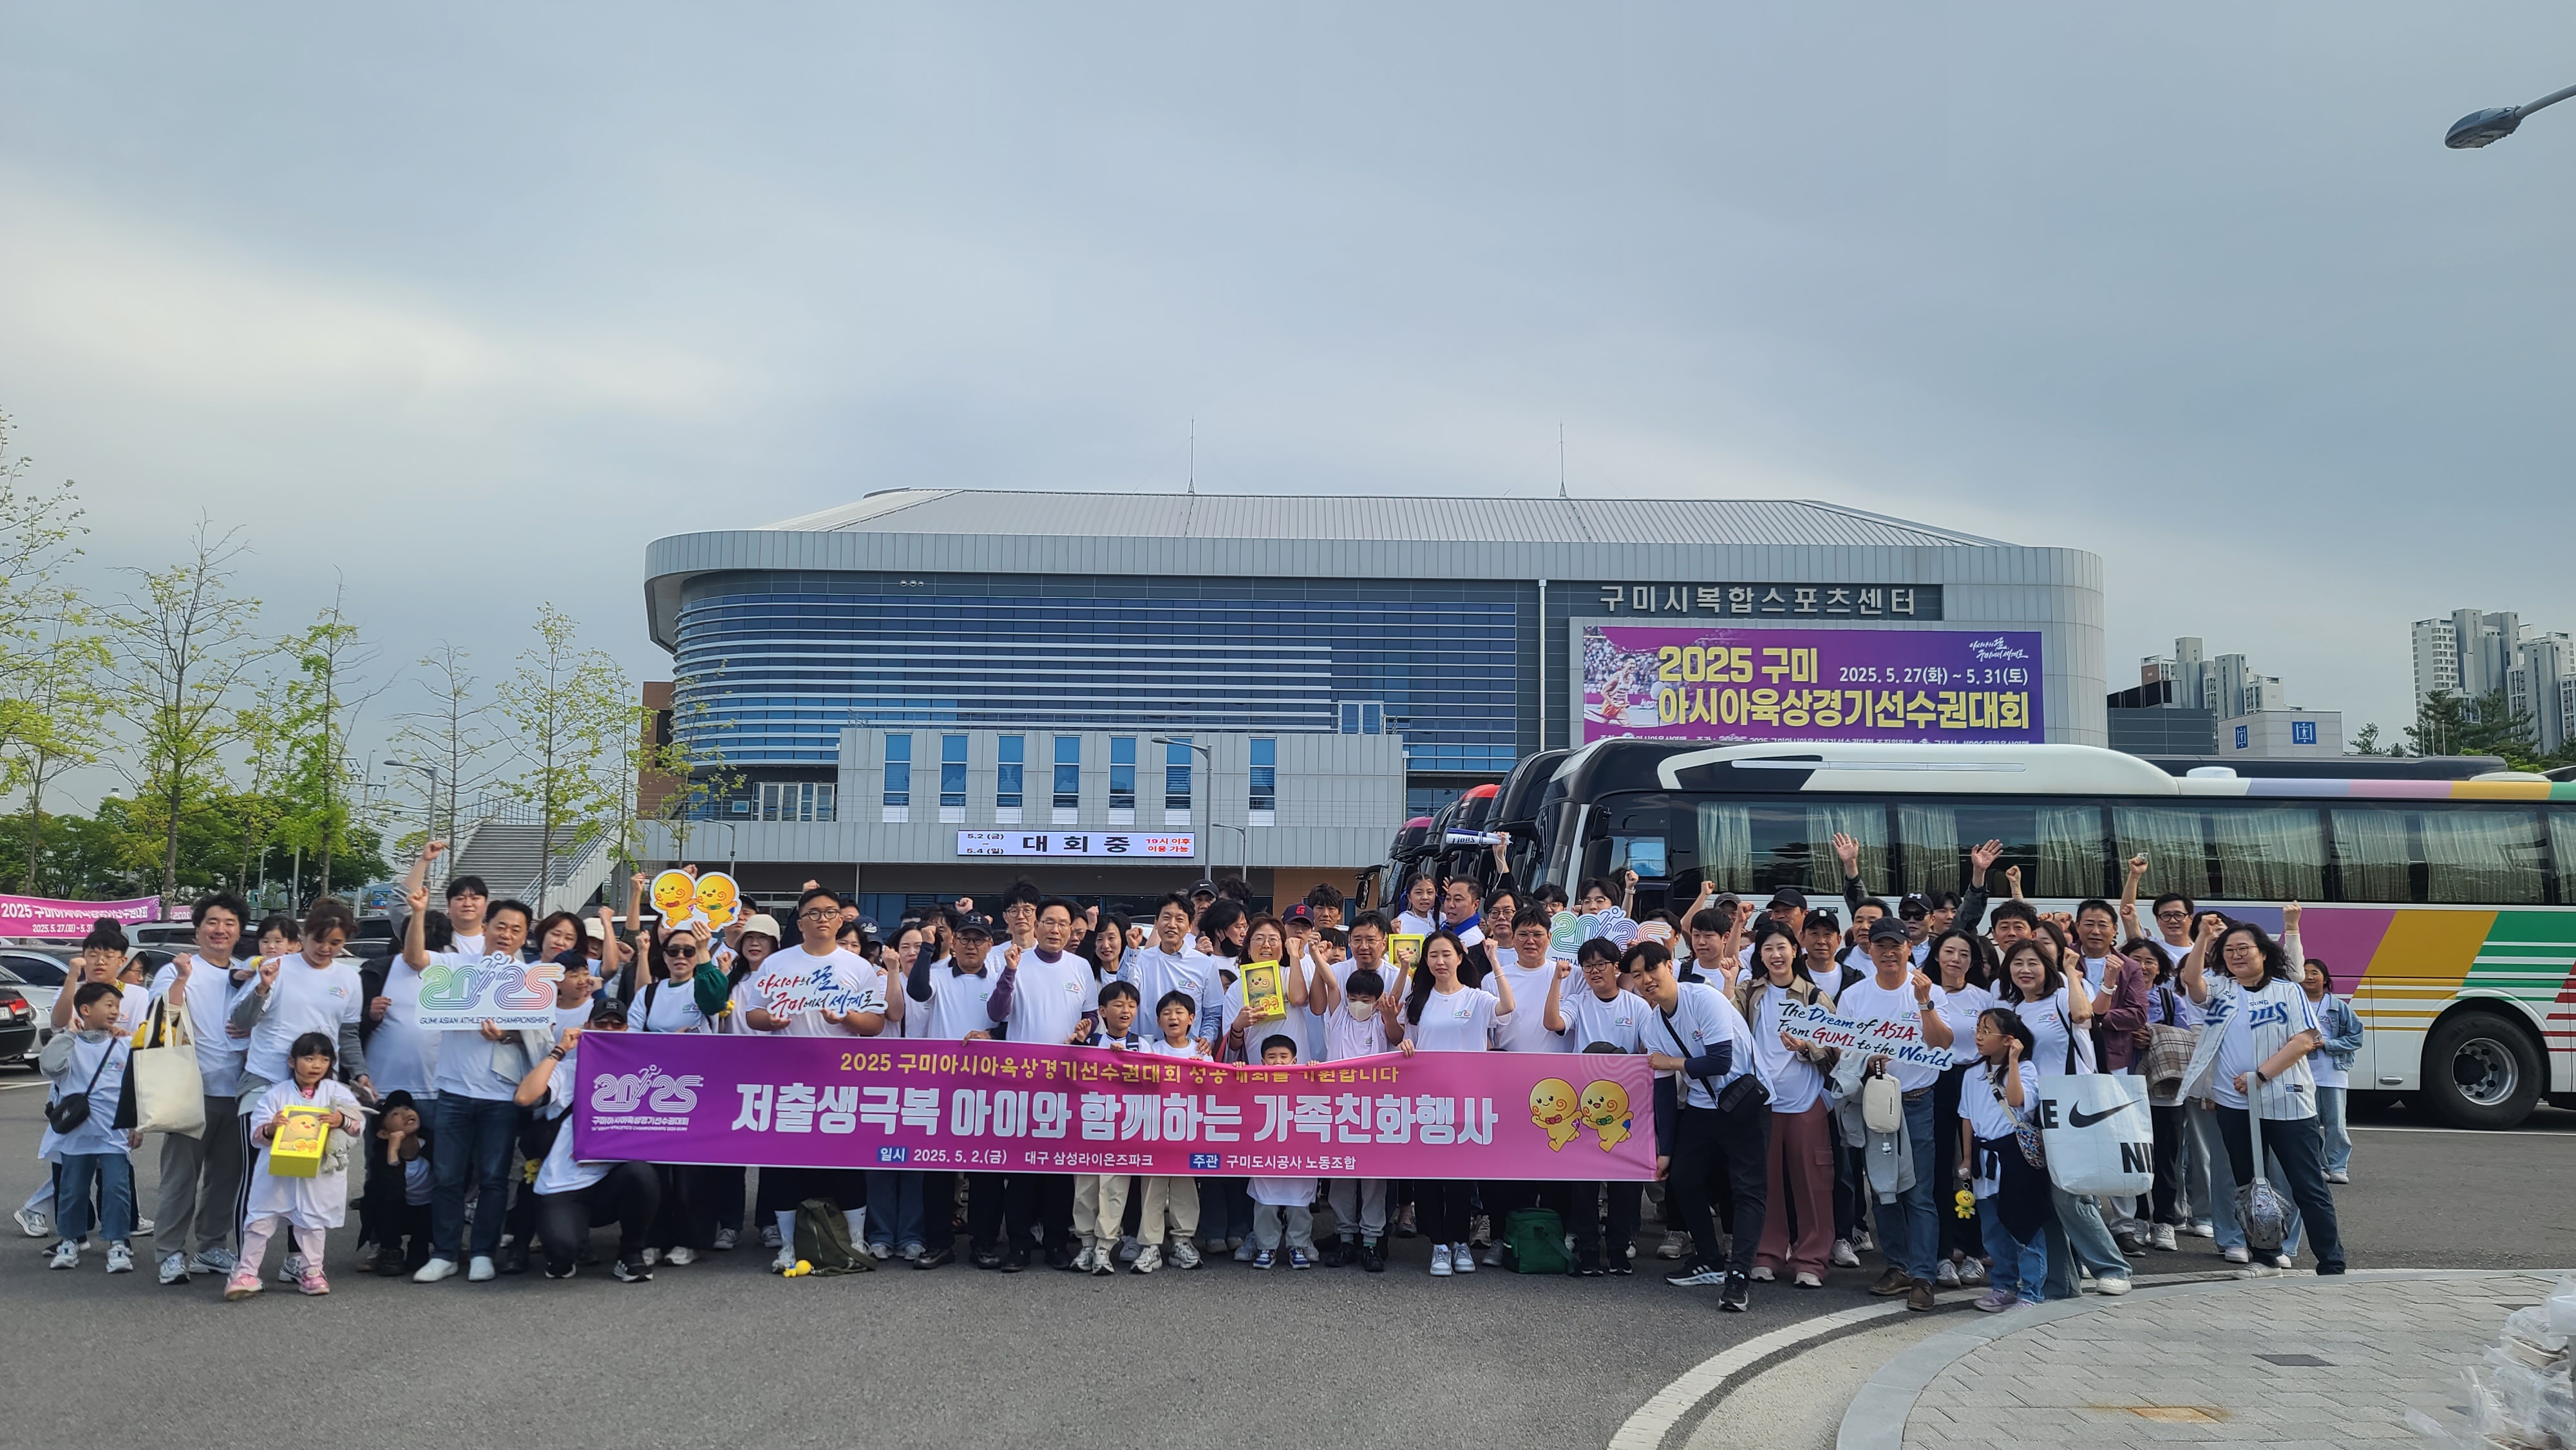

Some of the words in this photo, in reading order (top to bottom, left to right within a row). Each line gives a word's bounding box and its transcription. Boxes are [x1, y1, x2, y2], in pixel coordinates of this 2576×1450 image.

[1600, 586, 1914, 615] 구미시복합스포츠센터
[1659, 646, 1753, 683] 2025
[1761, 647, 1818, 684] 구미
[1839, 667, 1882, 683] 2025.
[1886, 668, 1900, 684] 5.
[1904, 667, 1948, 686] 27(화)
[1966, 668, 1981, 684] 5.
[1984, 668, 2029, 686] 31(토)
[1658, 688, 2029, 730] 아시아육상경기선수권대회
[1, 903, 32, 918] 2025
[420, 963, 562, 1010] 2025
[758, 974, 811, 995] 아시아의
[771, 992, 829, 1018] 구미에서
[828, 990, 885, 1013] 세계로
[1778, 1002, 1806, 1019] The
[1808, 1007, 1855, 1029] Dream
[1857, 1019, 1878, 1035] of
[1873, 1021, 1918, 1044] ASIA,
[1777, 1019, 1810, 1037] From
[1812, 1026, 1854, 1047] GUMI
[1857, 1040, 1871, 1050] to
[1872, 1042, 1897, 1056] the
[1898, 1046, 1953, 1068] World
[840, 1053, 891, 1071] 2025
[898, 1053, 1181, 1084] 구미아시아육상경기선수권대회
[1189, 1066, 1228, 1084] 성공
[1298, 1066, 1399, 1083] 기원합니다
[732, 1082, 940, 1136] 저출생극복
[951, 1089, 1072, 1138] 아이와
[1081, 1091, 1242, 1142] 함께하는
[1255, 1093, 1499, 1145] 가족친화행사
[880, 1148, 905, 1162] 일시
[913, 1149, 950, 1162] 2025.
[954, 1151, 967, 1163] 5.
[1025, 1152, 1049, 1165] 대구
[1053, 1152, 1153, 1167] 삼성라이온즈파크
[1193, 1154, 1218, 1169] 주관
[1226, 1154, 1302, 1169] 구미도시공사
[1305, 1156, 1356, 1170] 노동조합
